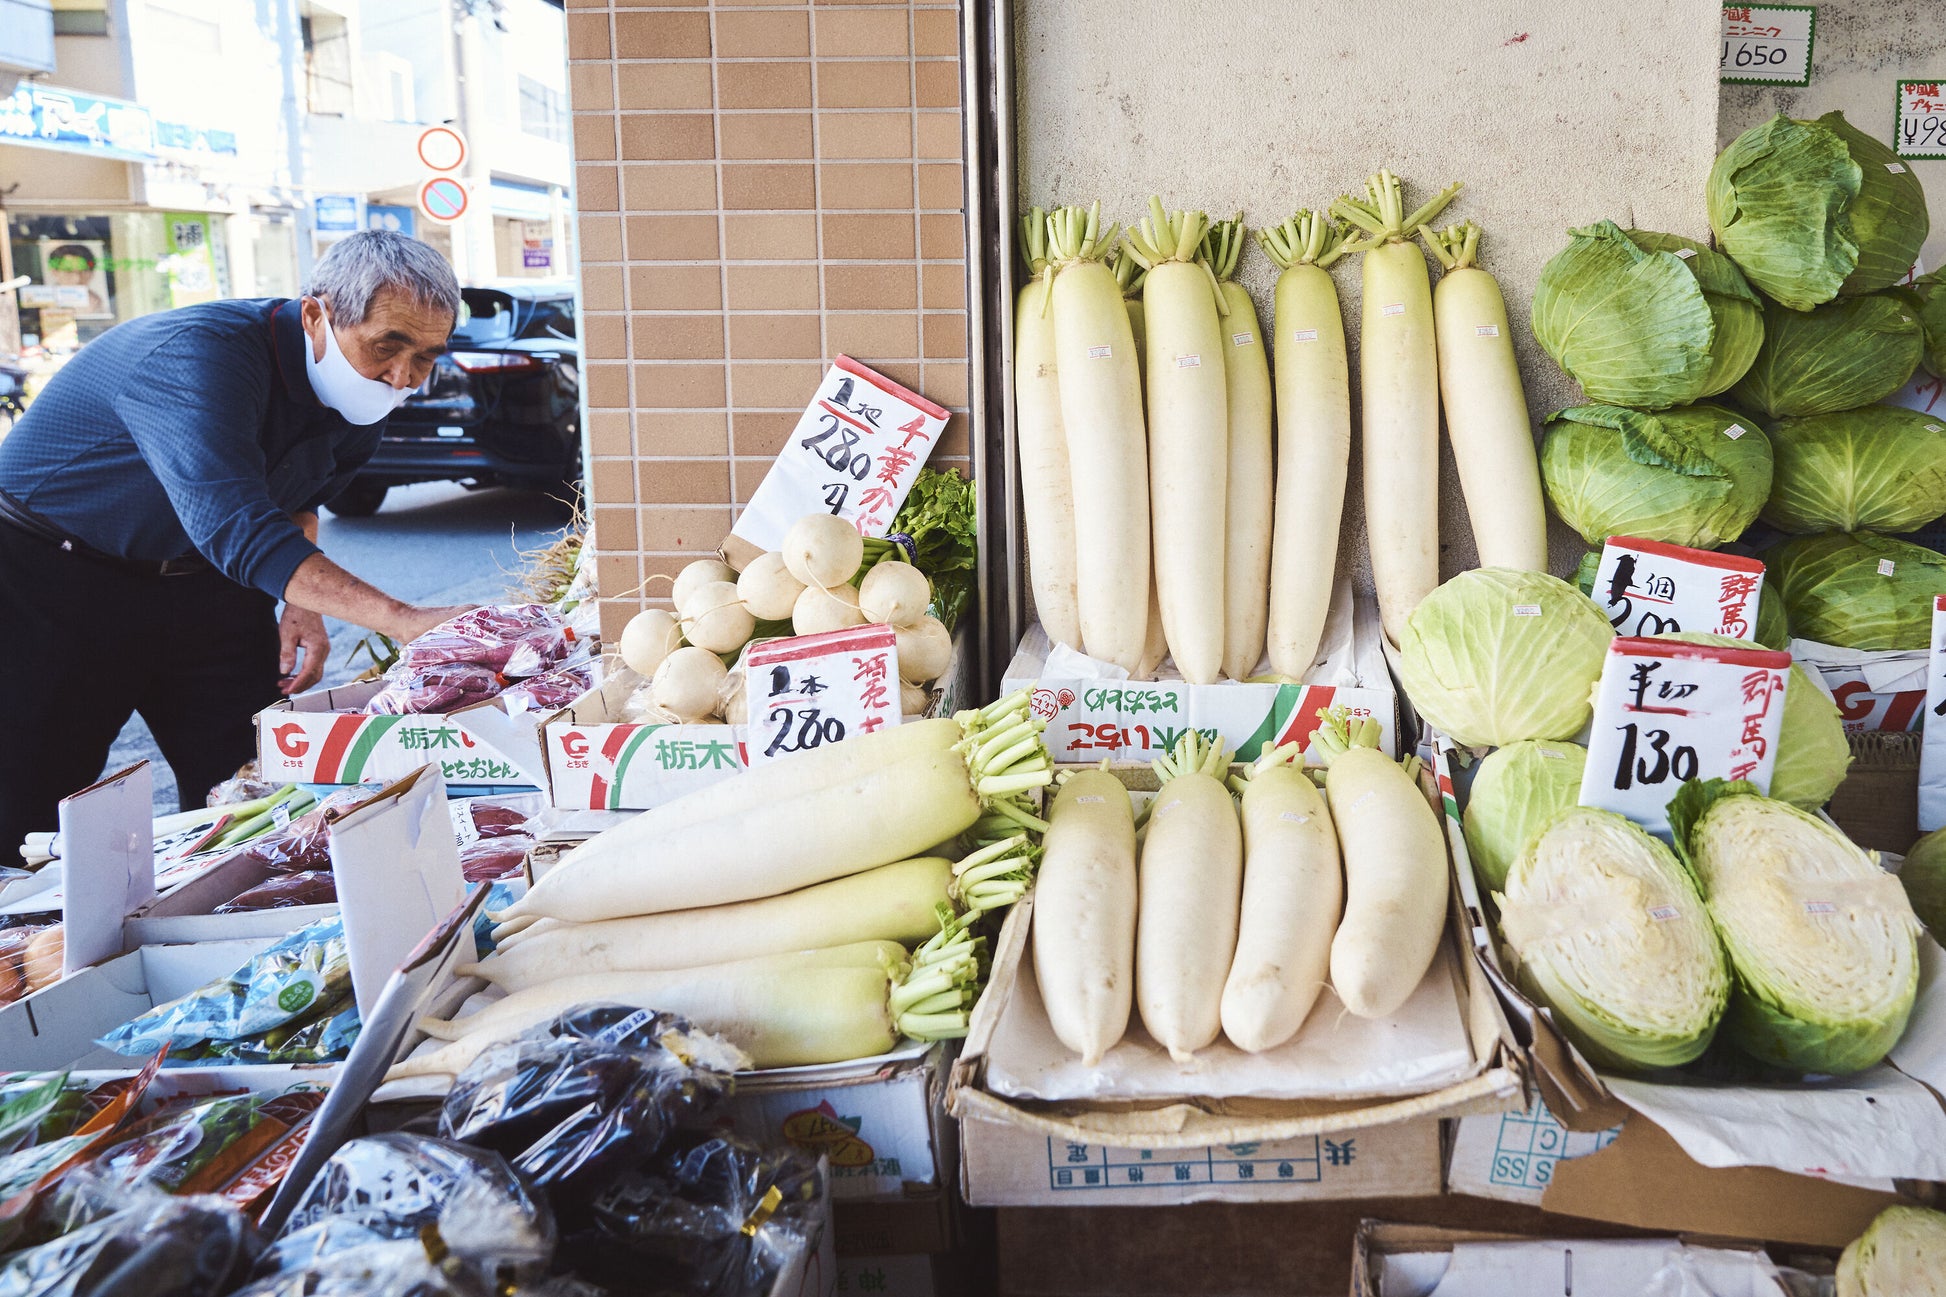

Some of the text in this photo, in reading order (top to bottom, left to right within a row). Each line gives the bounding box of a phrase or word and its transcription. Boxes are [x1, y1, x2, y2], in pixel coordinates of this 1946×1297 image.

[1905, 83, 1940, 97] 中国産
[1910, 98, 1946, 114] プチニ
[801, 414, 871, 481] 280
[1713, 574, 1760, 639] 群馬
[1083, 688, 1178, 715] とちおとめ
[763, 707, 846, 758] 280
[566, 760, 590, 769] とちぎ
[1614, 722, 1699, 790] 130
[1495, 1155, 1526, 1180] SS
